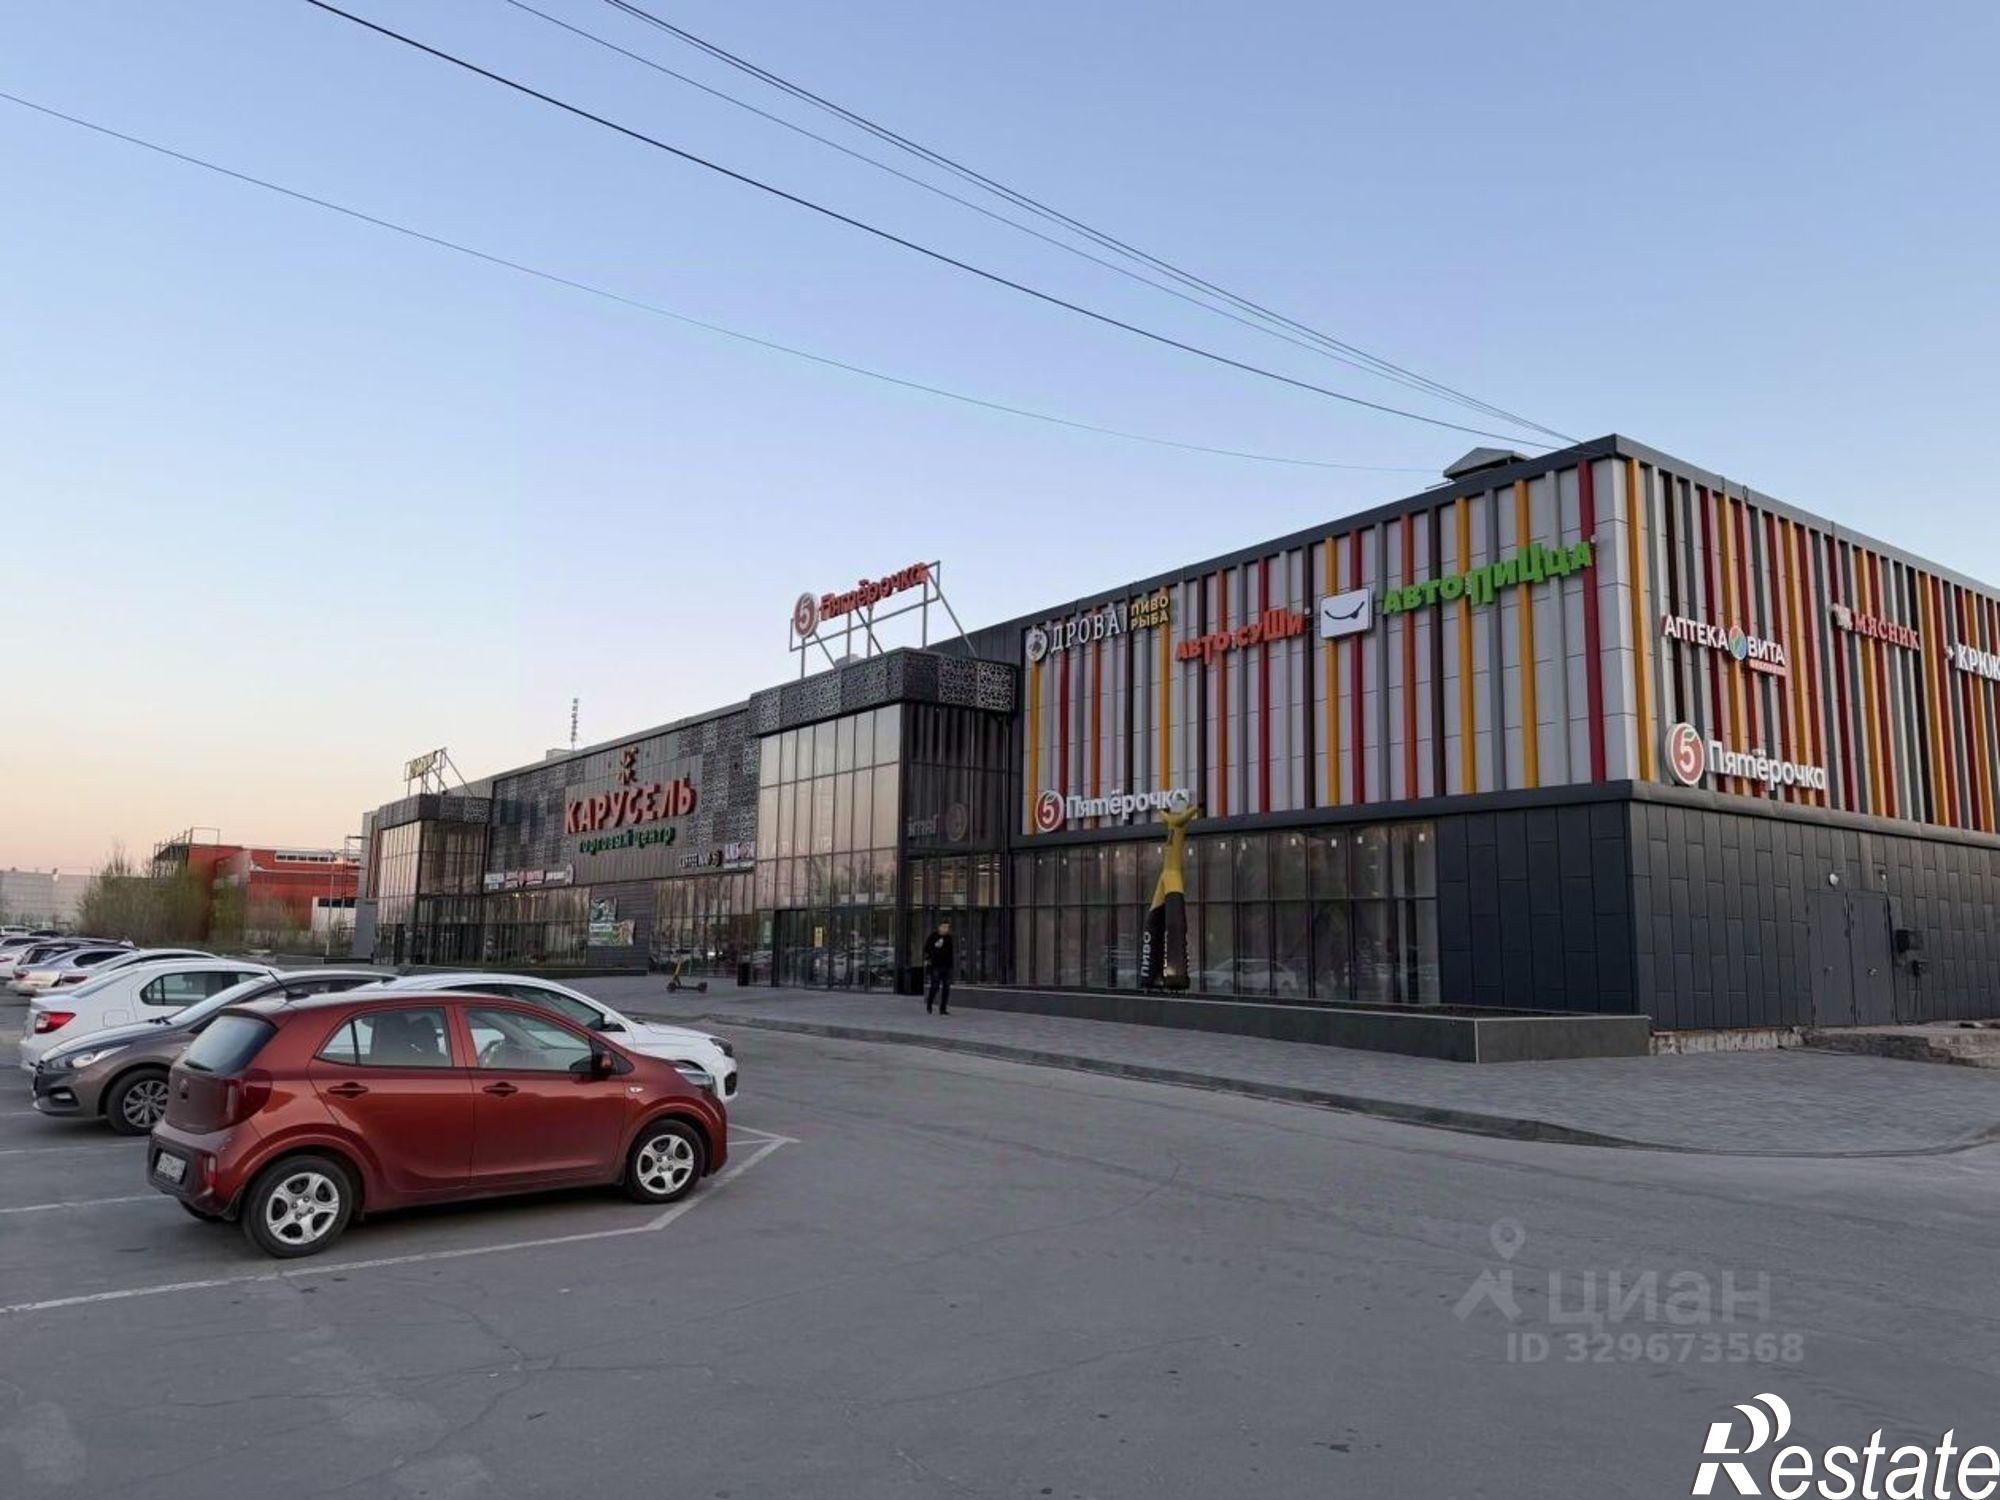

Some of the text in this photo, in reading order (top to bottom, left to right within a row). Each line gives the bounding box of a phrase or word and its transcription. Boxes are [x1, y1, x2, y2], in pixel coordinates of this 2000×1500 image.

[1131, 595, 1169, 617] ПИВО
[1131, 609, 1169, 631] РЫБА
[1050, 608, 1120, 654] ДРОВА
[1664, 615, 1729, 650] АПТЕКА
[1747, 635, 1786, 667] ВИТА
[1709, 739, 1826, 791] Пятёрочка
[565, 776, 697, 834] КАРУСЕЛЬ
